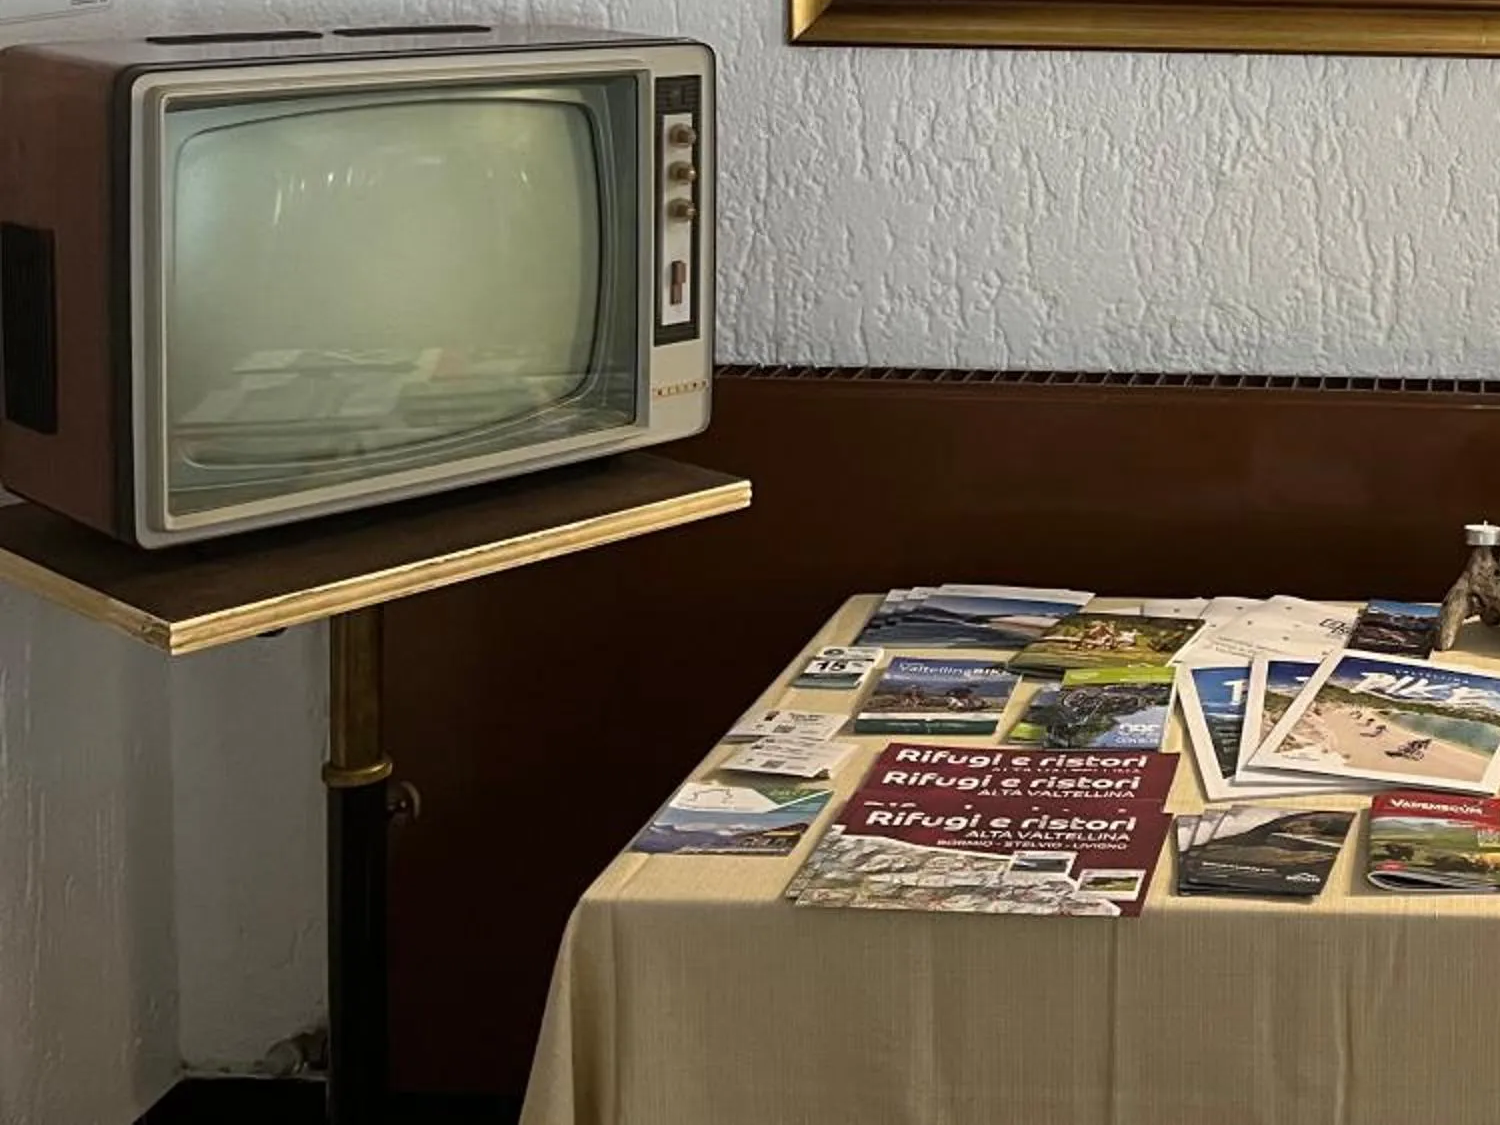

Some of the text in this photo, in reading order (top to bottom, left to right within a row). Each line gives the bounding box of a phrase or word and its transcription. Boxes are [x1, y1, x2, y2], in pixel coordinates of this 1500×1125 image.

[896, 749, 1147, 768] Rifugi e ristori
[882, 770, 1140, 790] Rifugi e ristori
[977, 789, 1135, 798] ALTA VALTELLINA
[865, 810, 1137, 831] Rifugi e ristori
[965, 830, 1131, 842] ALTA VALTELLINA
[1003, 840, 1063, 850] STELVIO
[1072, 842, 1128, 851] LIVIGNO
